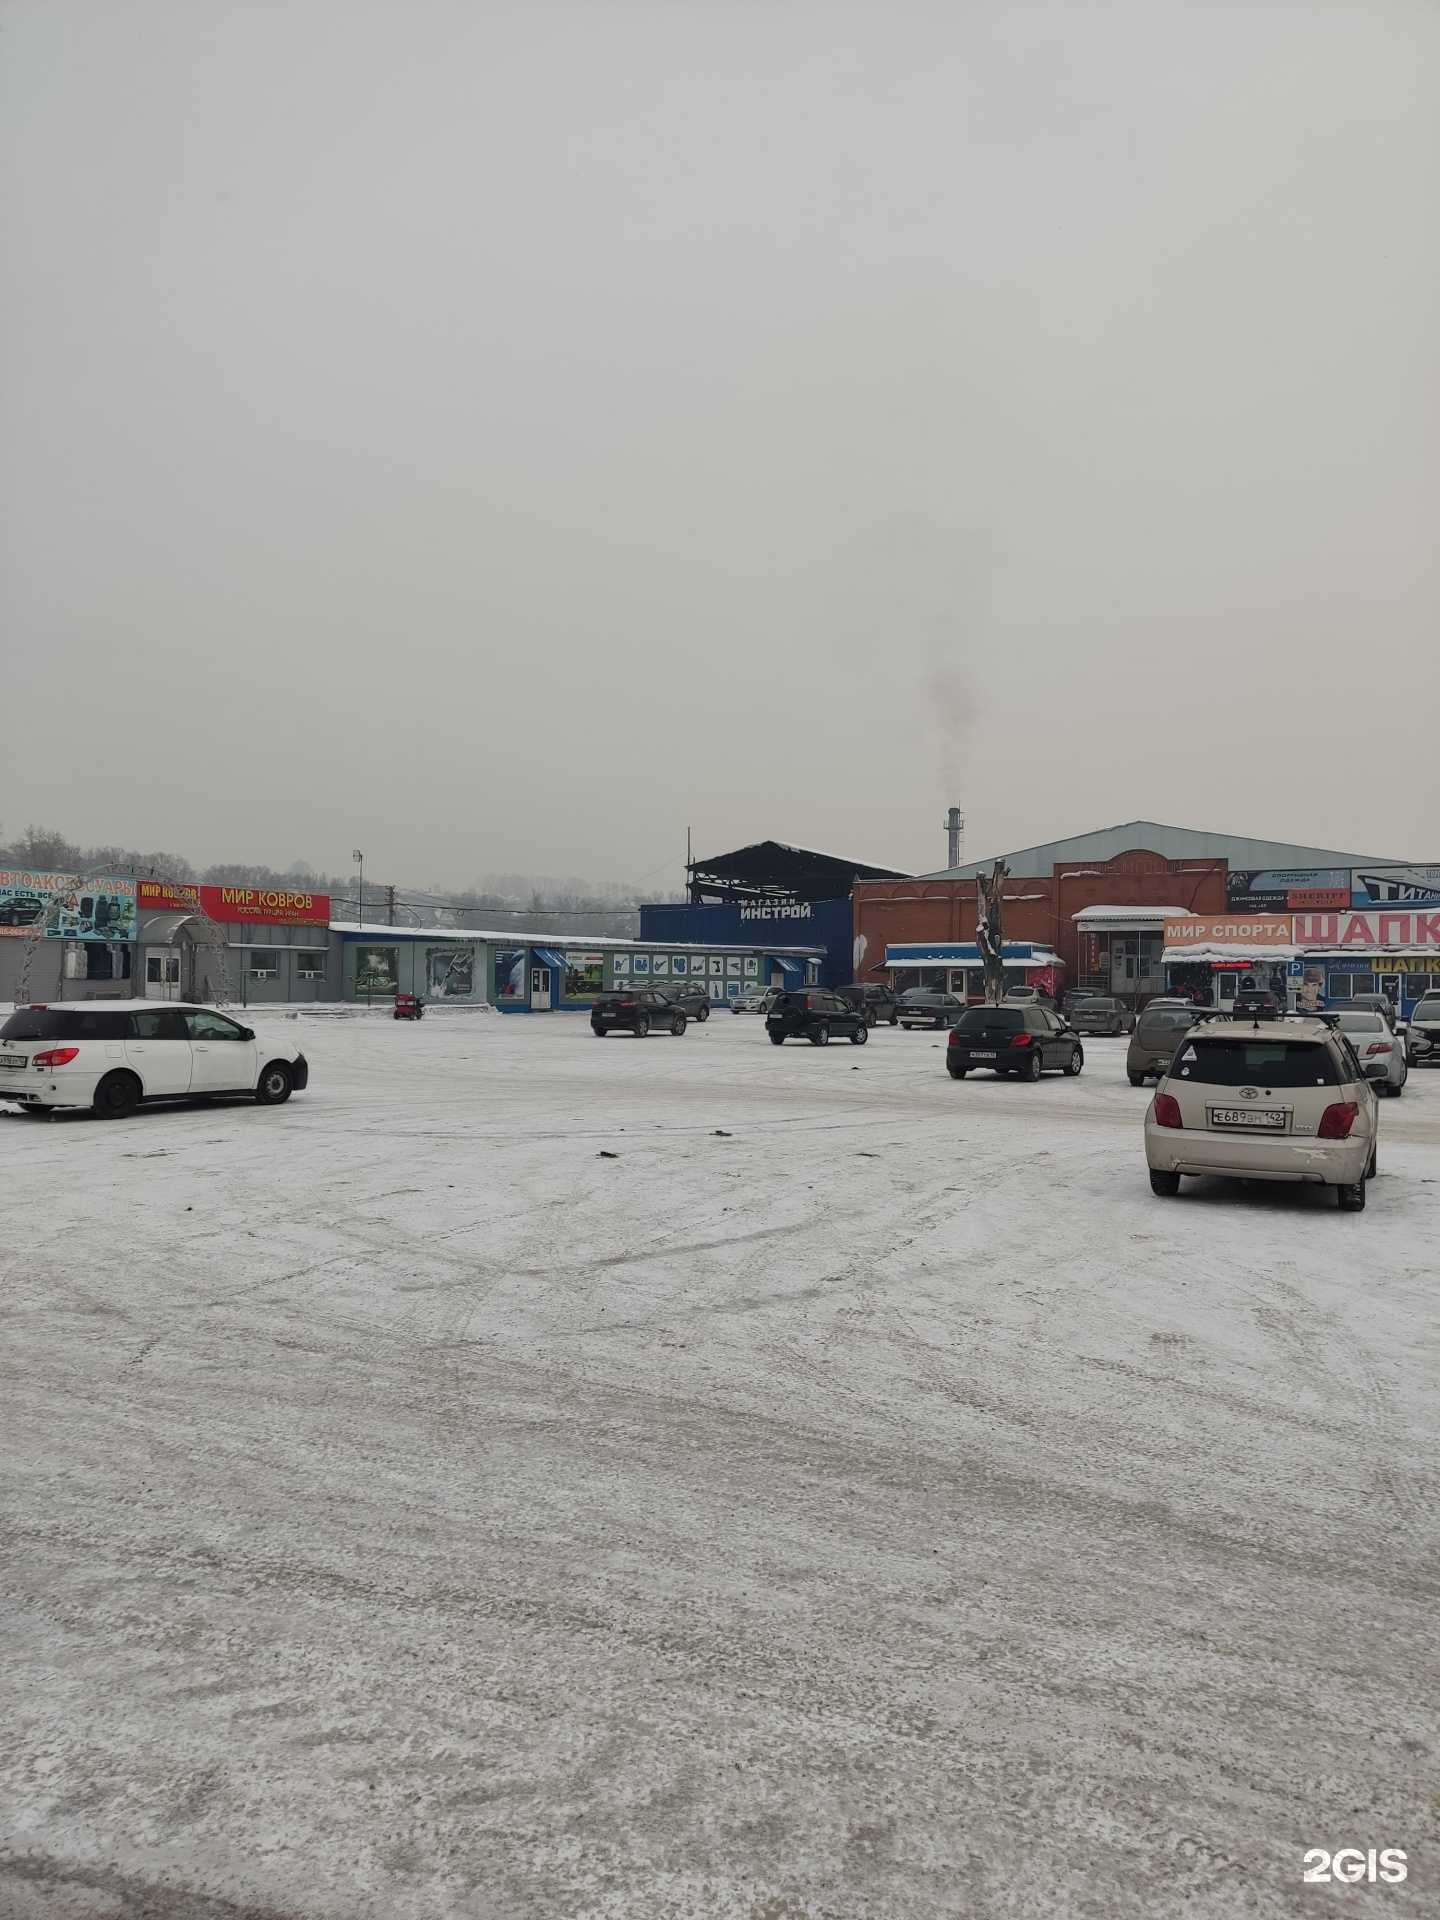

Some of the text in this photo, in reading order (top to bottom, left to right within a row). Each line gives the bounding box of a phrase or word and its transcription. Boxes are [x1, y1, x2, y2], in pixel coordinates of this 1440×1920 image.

[15, 890, 35, 898] ЕСТЬ
[141, 884, 160, 897] МИР
[222, 888, 313, 909] МИР КОВРОВ
[740, 898, 796, 906] МАГАЗИН
[1167, 924, 1289, 938] МИР СПОРТА
